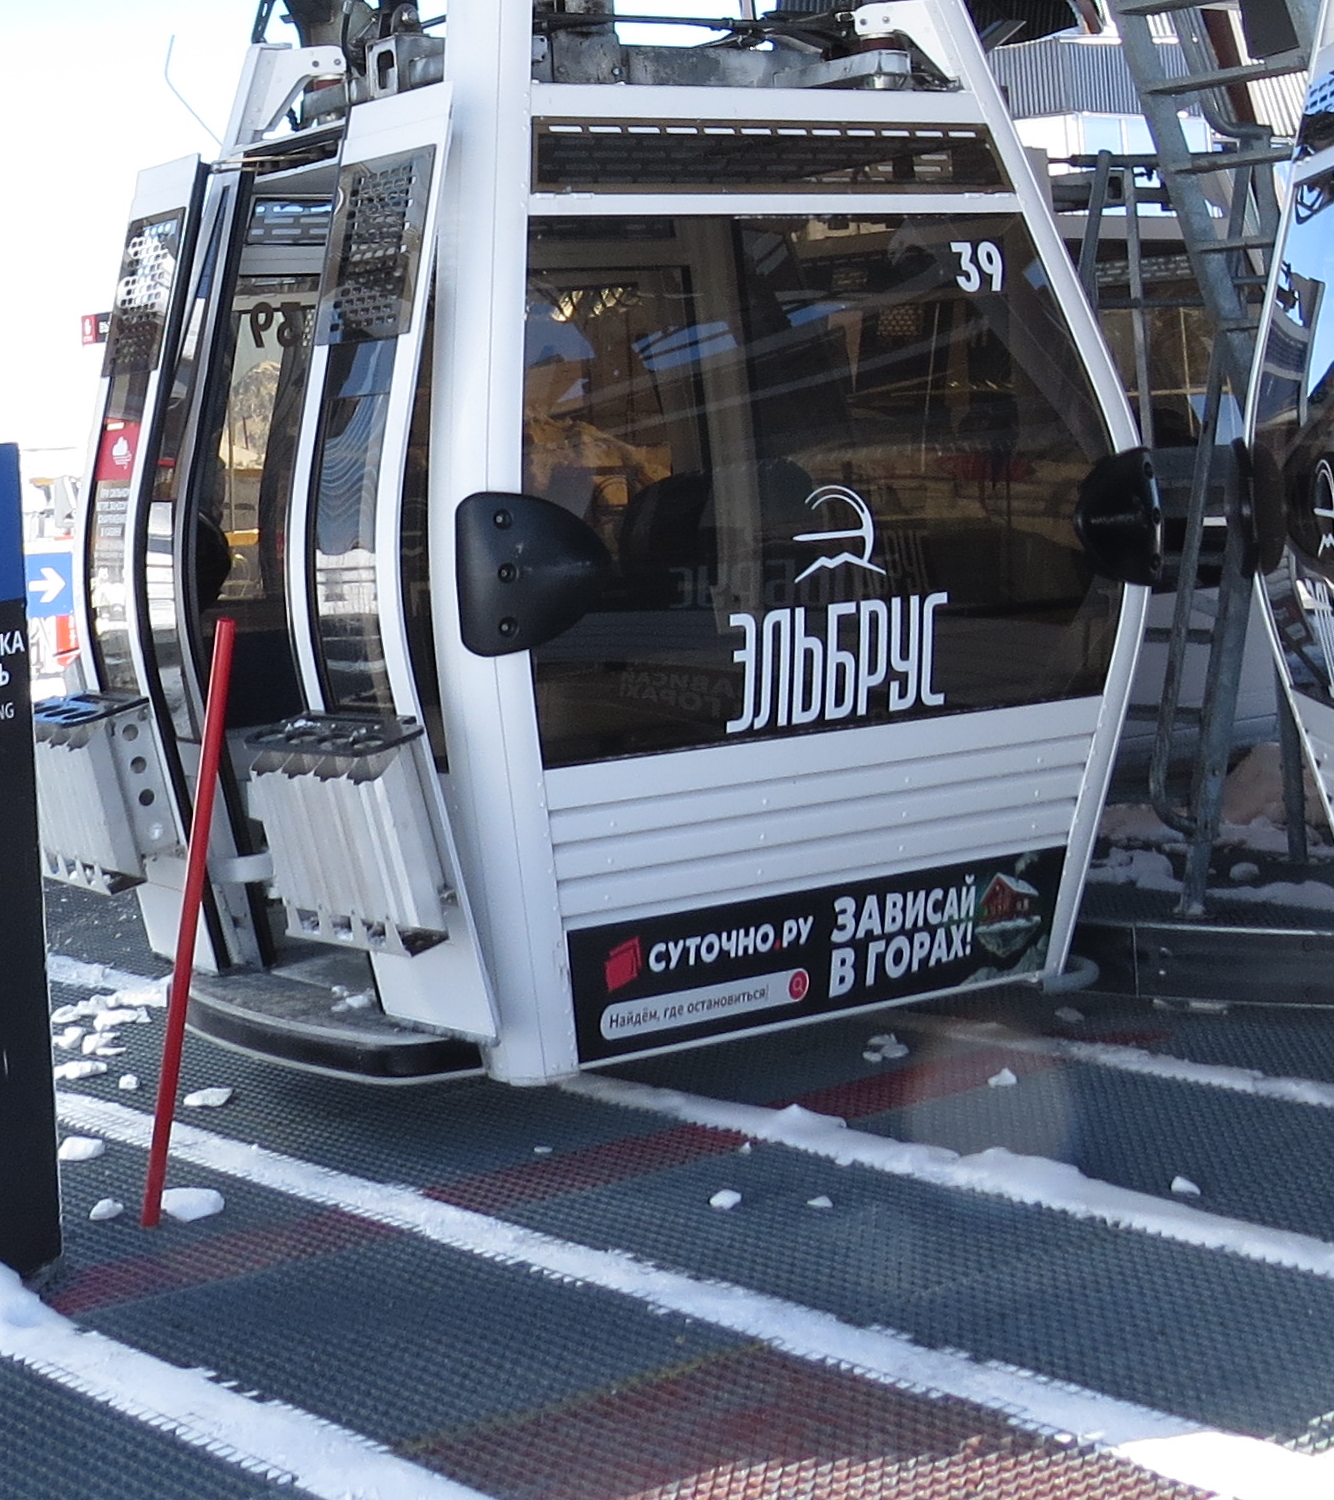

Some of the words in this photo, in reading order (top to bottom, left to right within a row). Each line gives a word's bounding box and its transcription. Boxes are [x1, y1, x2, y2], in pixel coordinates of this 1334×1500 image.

[950, 240, 1003, 292] 39
[726, 591, 948, 735] ЭЛЬБРУС
[830, 874, 978, 944] ЗАВИСАЙ
[829, 948, 856, 999] В
[865, 920, 973, 987] ГОРАХ!
[609, 1004, 662, 1033] Найдём,
[663, 1001, 685, 1022] где
